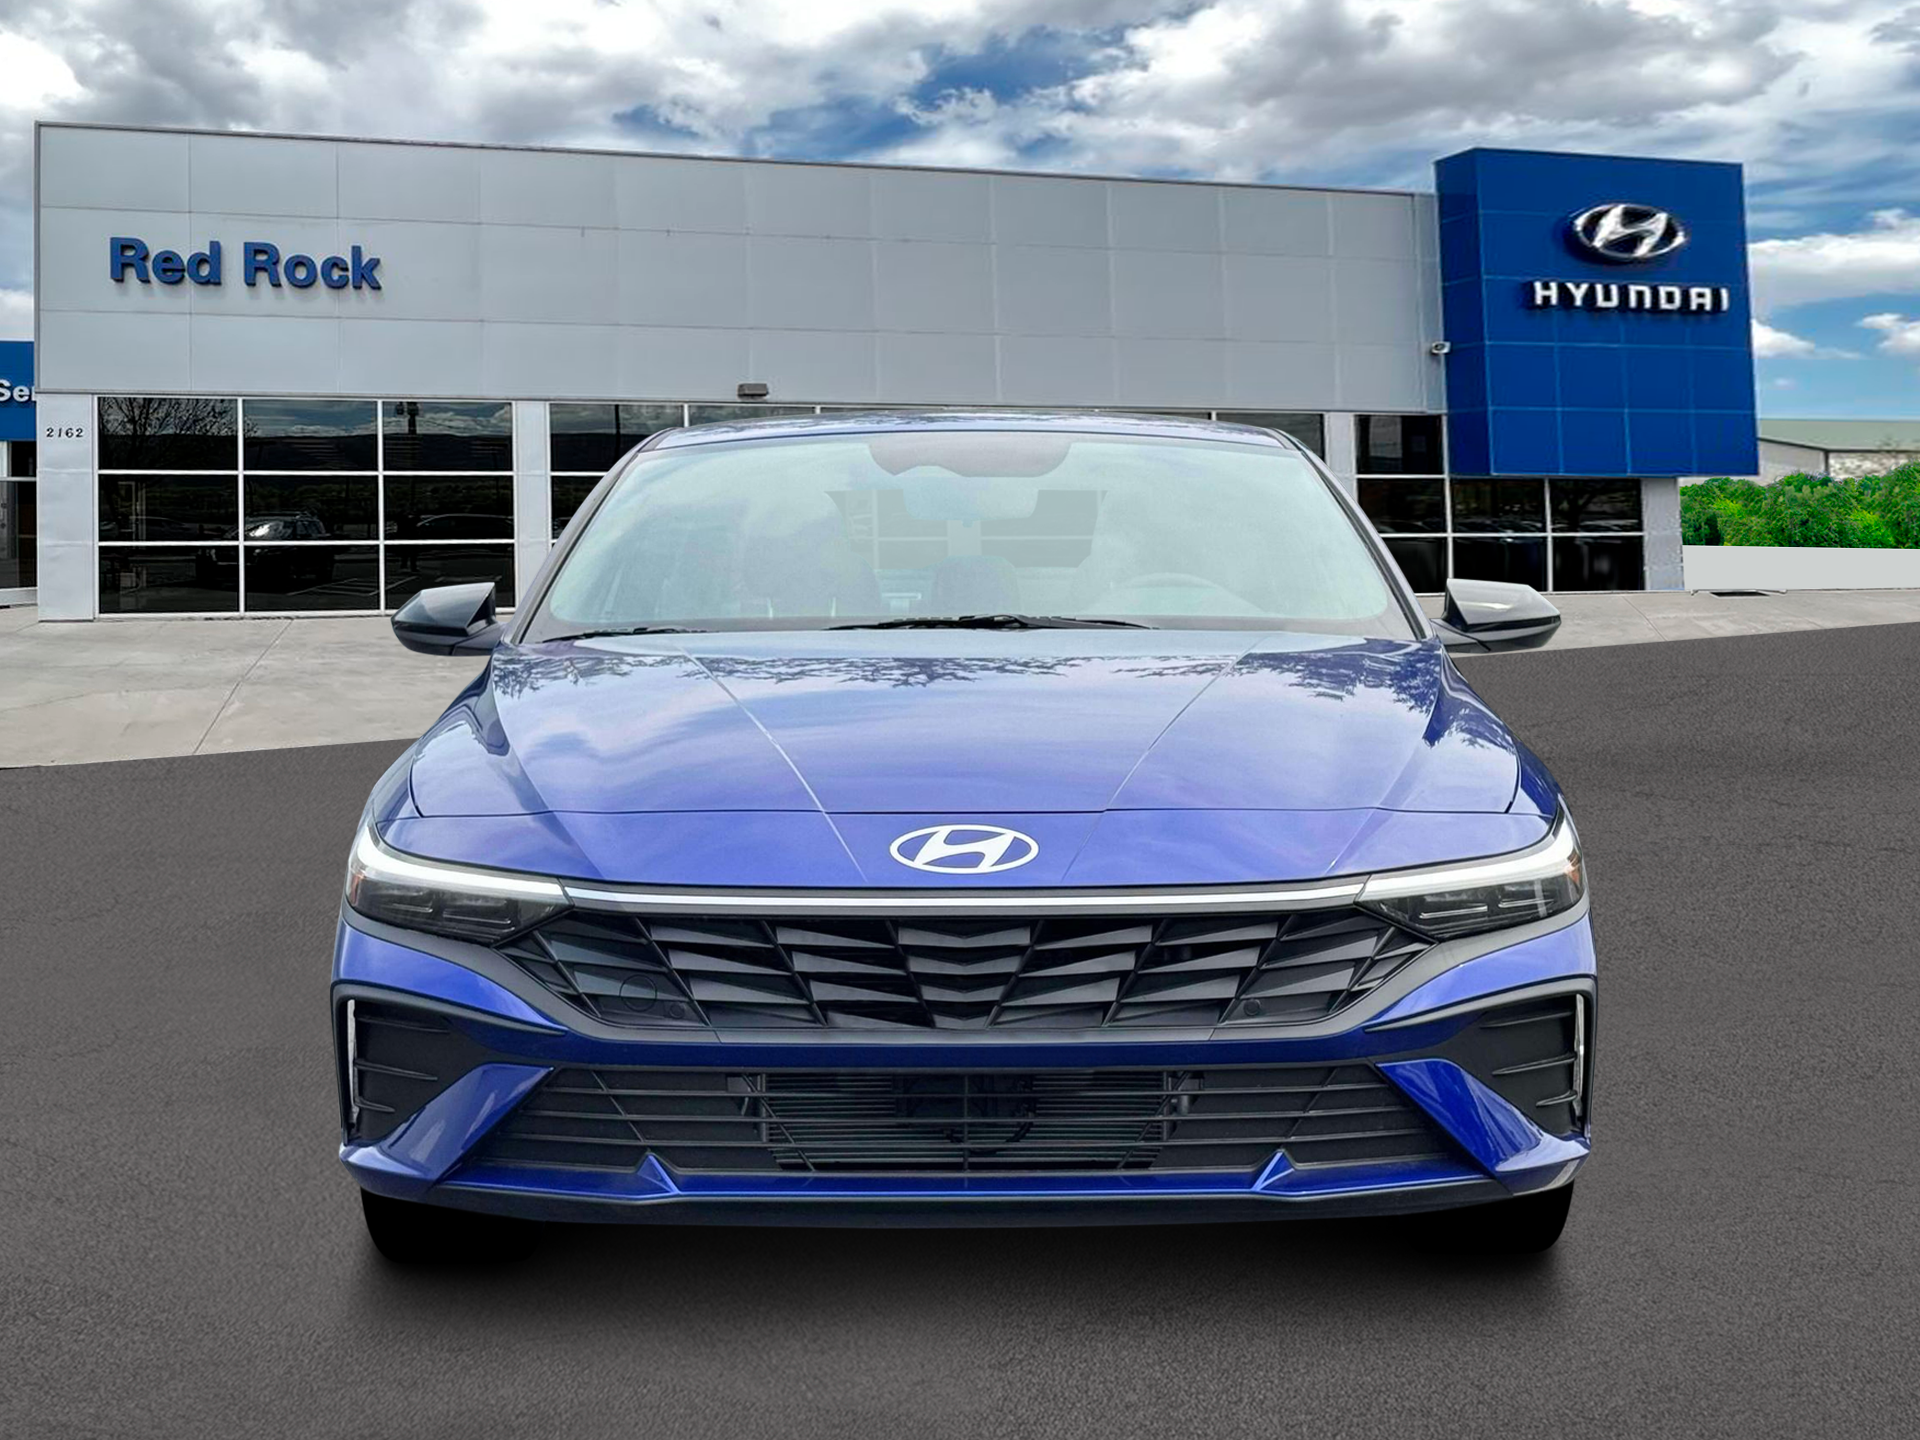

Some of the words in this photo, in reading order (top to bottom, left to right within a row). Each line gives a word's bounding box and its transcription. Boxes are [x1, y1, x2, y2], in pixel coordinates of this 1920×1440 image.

[109, 237, 222, 286] Red
[243, 241, 382, 291] Rock
[1533, 281, 1729, 312] HYUNDAI
[0, 379, 36, 402] Se
[46, 427, 84, 438] 2162
